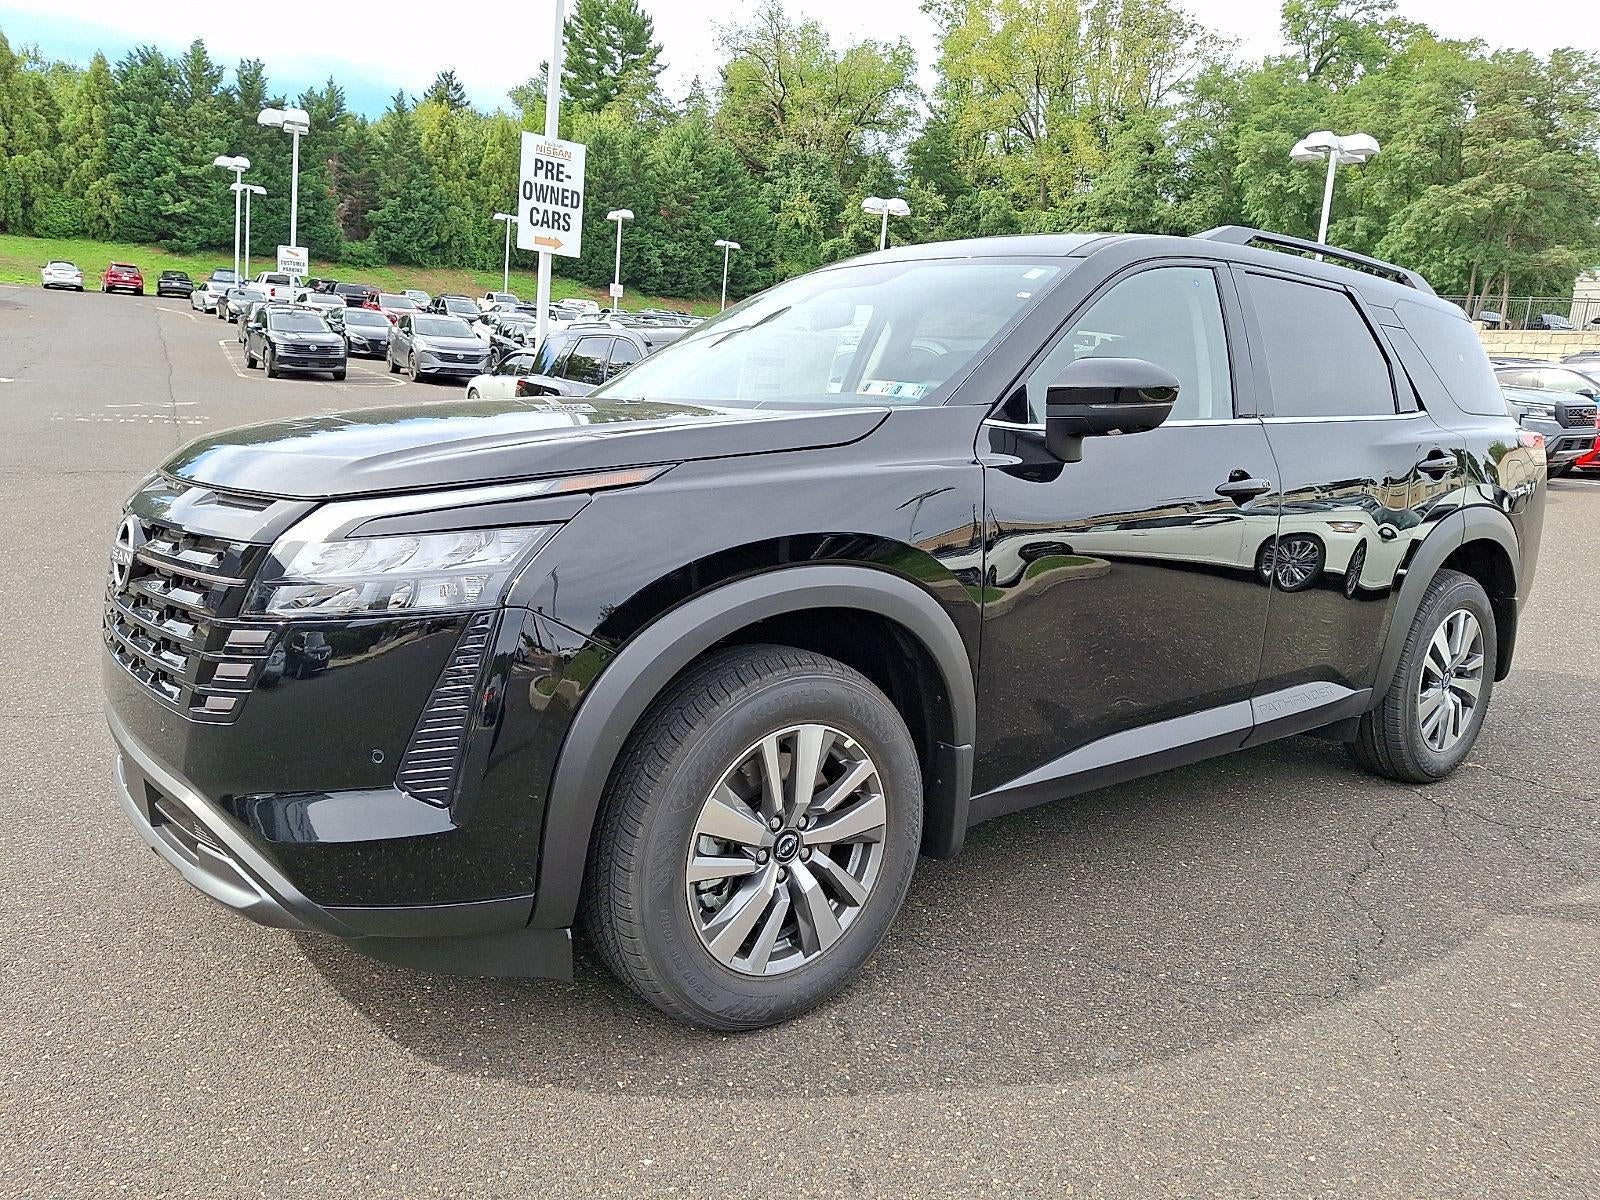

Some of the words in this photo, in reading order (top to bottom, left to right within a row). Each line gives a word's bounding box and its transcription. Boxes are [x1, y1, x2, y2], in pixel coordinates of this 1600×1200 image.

[536, 144, 572, 159] NISSAN
[534, 158, 572, 182] PRE-
[522, 180, 580, 209] OWNED
[529, 206, 572, 232] CARS
[1258, 685, 1335, 715] PATHFINDER
